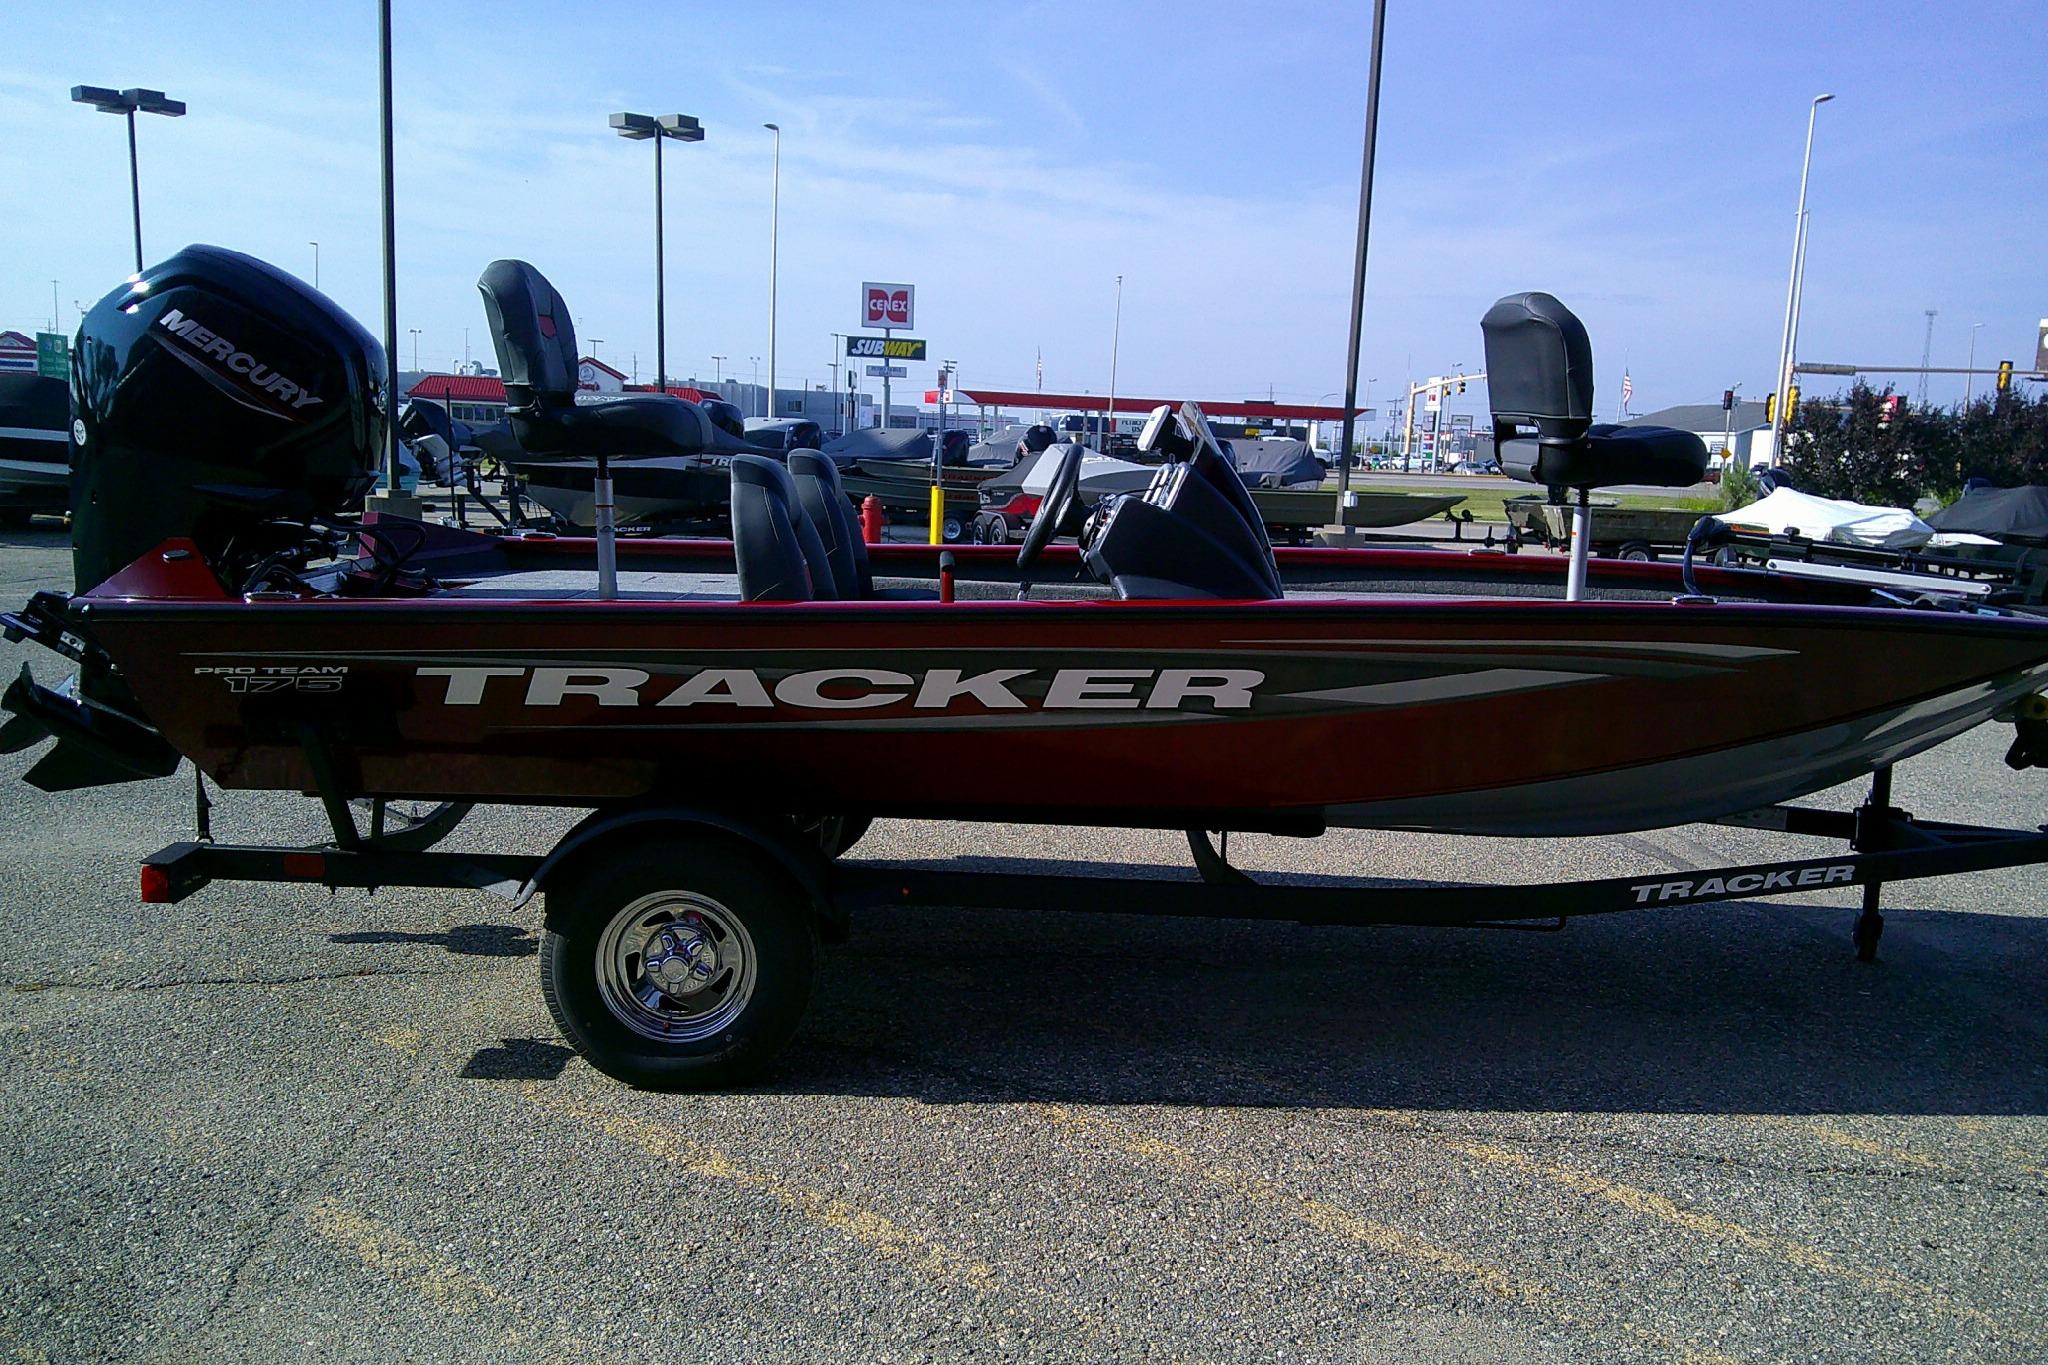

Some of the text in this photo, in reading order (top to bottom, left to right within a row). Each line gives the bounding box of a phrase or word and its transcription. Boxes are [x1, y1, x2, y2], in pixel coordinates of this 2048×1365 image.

[869, 298, 907, 312] CENEX
[851, 339, 923, 357] SUBWAY
[159, 308, 324, 409] MERCURY
[194, 666, 349, 675] PRO TEAM
[223, 676, 343, 693] 175
[415, 667, 1266, 708] TRACKER
[1630, 865, 1856, 903] TRACKER
